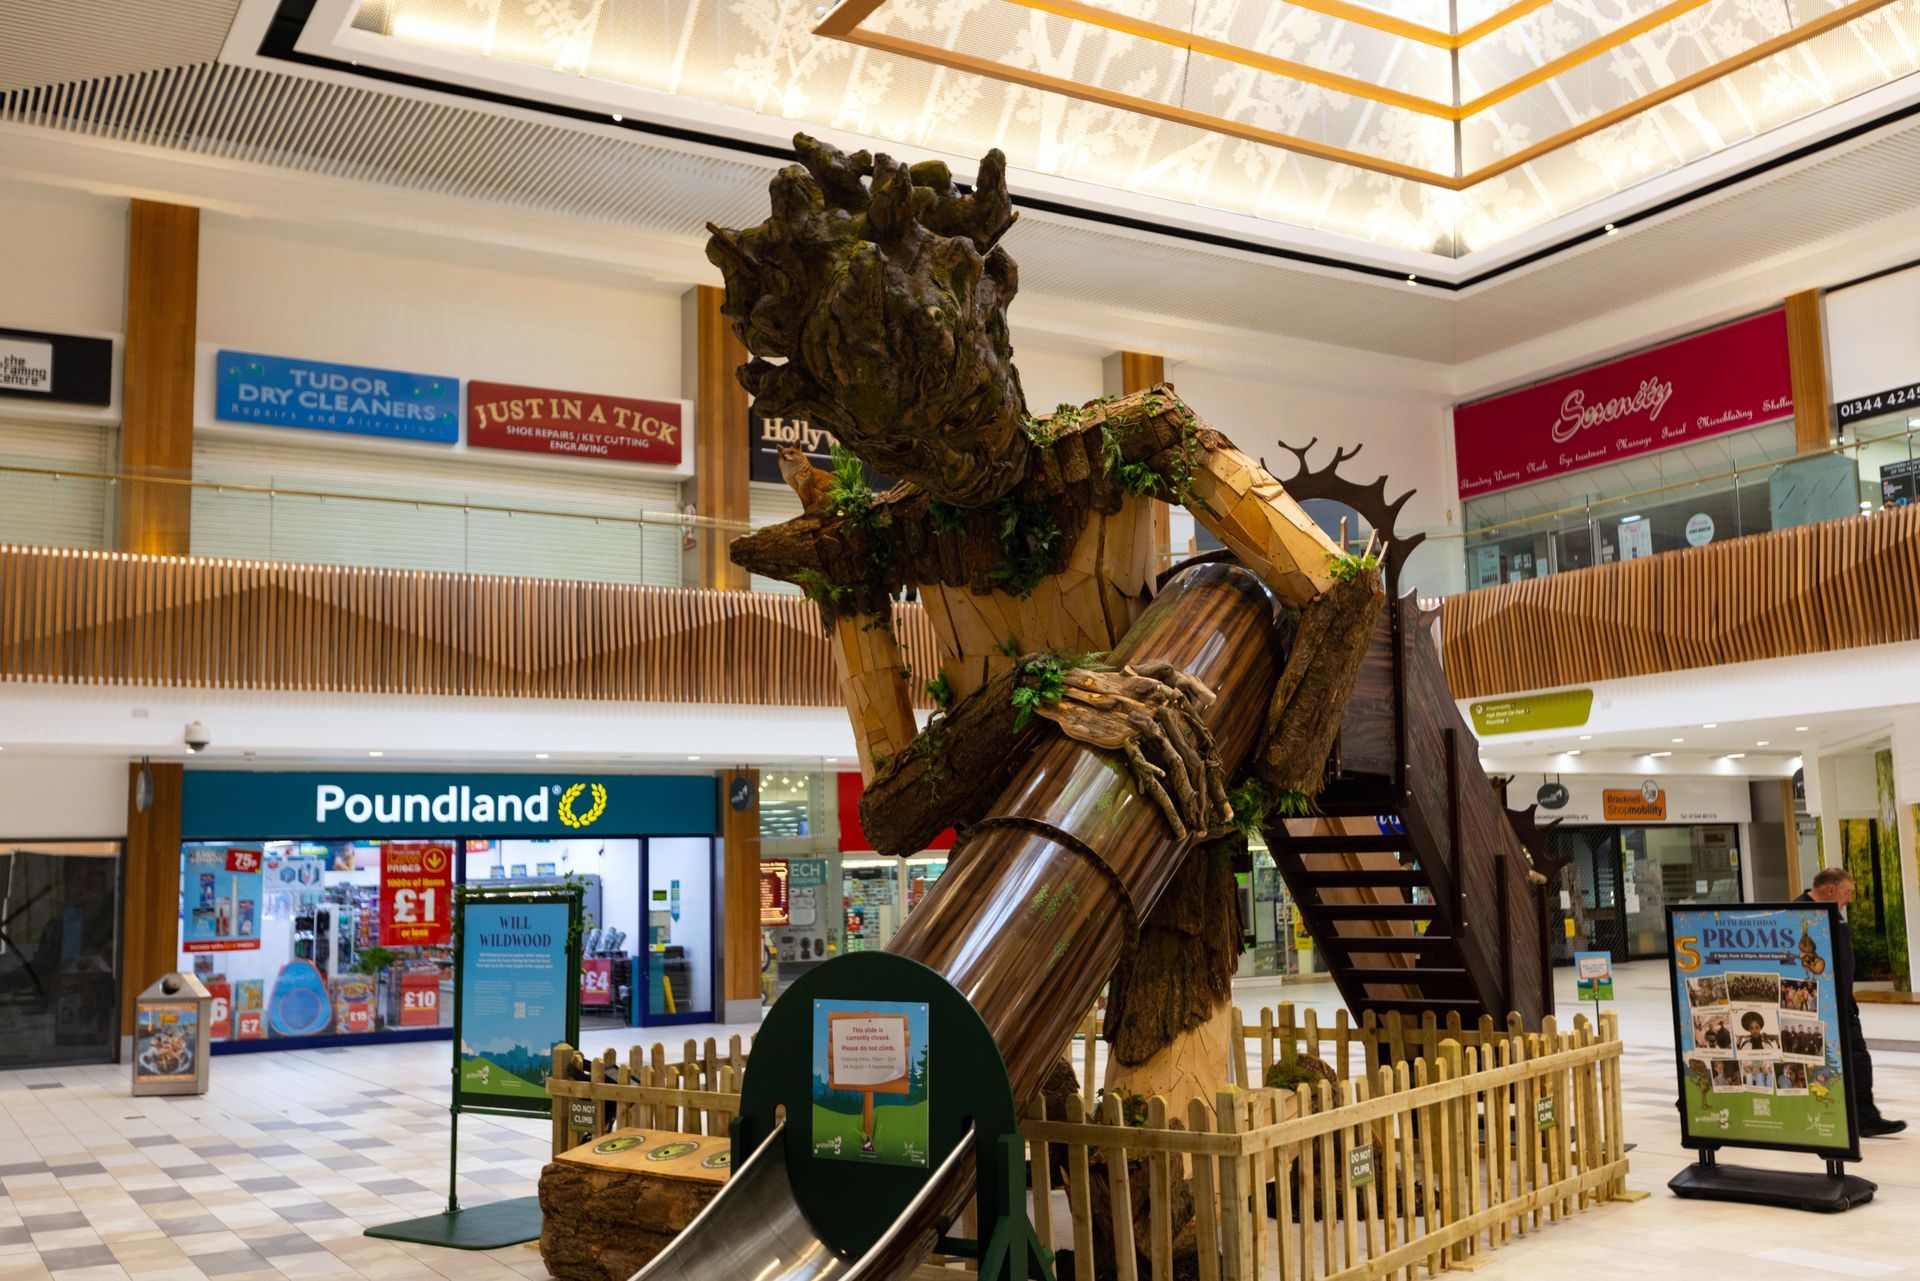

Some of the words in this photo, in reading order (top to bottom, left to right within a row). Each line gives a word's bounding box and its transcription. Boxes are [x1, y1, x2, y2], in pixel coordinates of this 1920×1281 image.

[0, 363, 46, 380] raming
[289, 368, 390, 397] TUDOR
[238, 383, 293, 405] DRY
[298, 391, 436, 421] CLEANERS
[1552, 376, 1673, 443] Serenity
[1841, 396, 1882, 417] 01344
[231, 403, 296, 420] Repairs
[308, 413, 335, 424] and
[475, 398, 543, 430] JUST
[549, 398, 582, 420] IN
[587, 403, 607, 424] A
[613, 406, 678, 446] TICK
[506, 424, 534, 436] SHOE
[535, 428, 574, 440] REPAIRS
[582, 433, 601, 444] KEY
[604, 435, 649, 448] CUTTING
[550, 440, 608, 455] ENGRAVING
[1559, 453, 1573, 467] Eye
[1575, 447, 1607, 463] treatment
[1616, 436, 1652, 451] Massage
[1661, 423, 1686, 439] Facial
[316, 784, 549, 823] Poundland
[1607, 803, 1663, 817] Shopmobility
[386, 863, 421, 873] PRICES
[788, 863, 820, 877] ECH
[393, 887, 436, 923] £1
[499, 915, 532, 930] WILL
[401, 929, 411, 938] or
[411, 928, 429, 937] less
[479, 933, 552, 948] WILDWOOD
[1702, 927, 1796, 949] PROMS
[404, 990, 436, 1008] £10
[241, 1018, 258, 1033] £7
[572, 1103, 582, 1112] DO
[582, 1104, 596, 1114] NOT
[574, 1114, 593, 1124] CLIMB
[1350, 1152, 1360, 1164] DO
[1360, 1149, 1371, 1160] NOT
[1353, 1162, 1370, 1176] CLIMB
